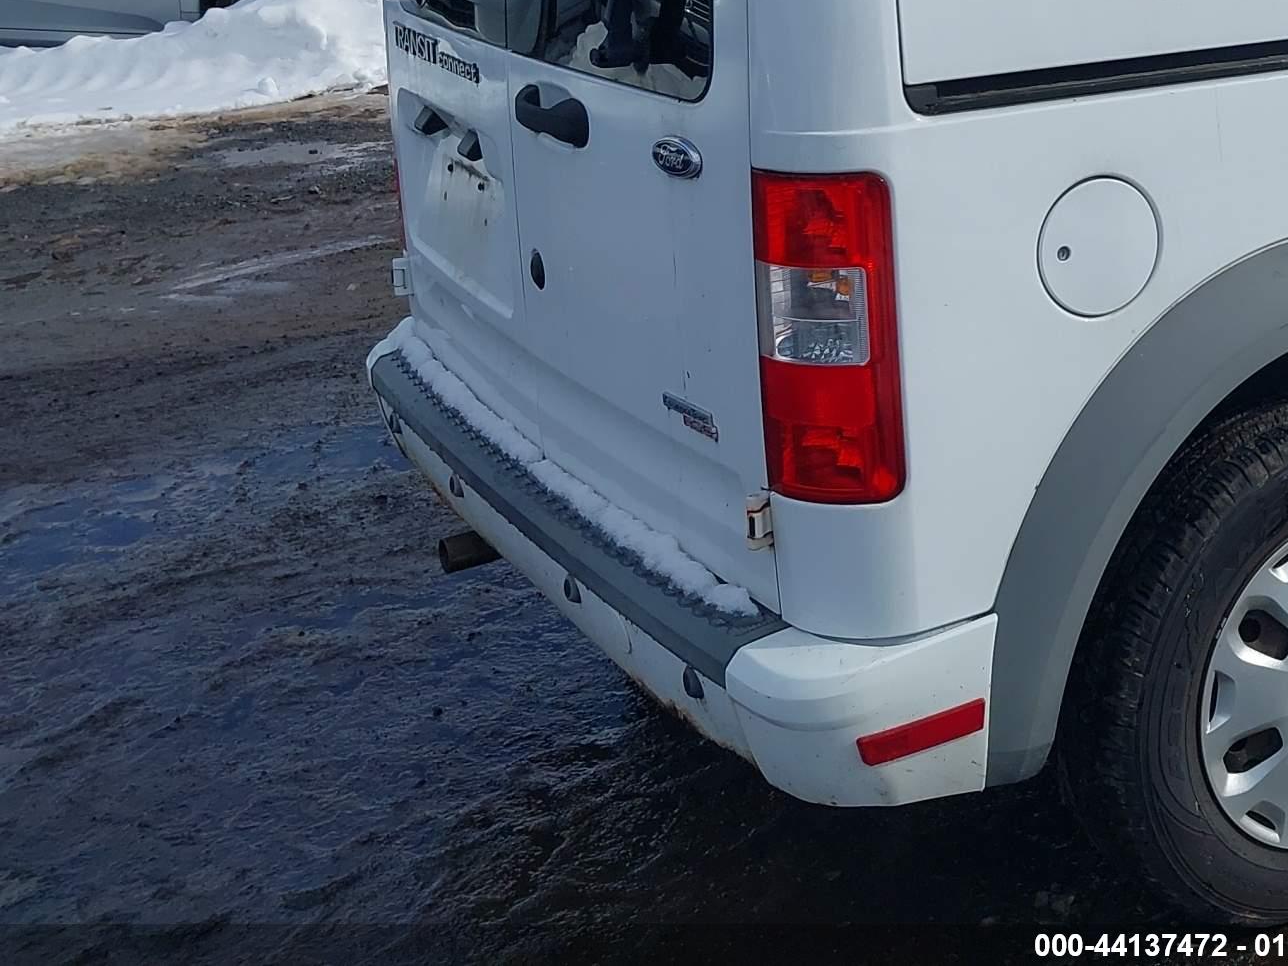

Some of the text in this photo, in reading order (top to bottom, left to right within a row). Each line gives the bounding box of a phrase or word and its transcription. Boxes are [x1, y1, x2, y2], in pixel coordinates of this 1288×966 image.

[393, 23, 481, 85] TRANSIT connect
[658, 143, 685, 170] Ford
